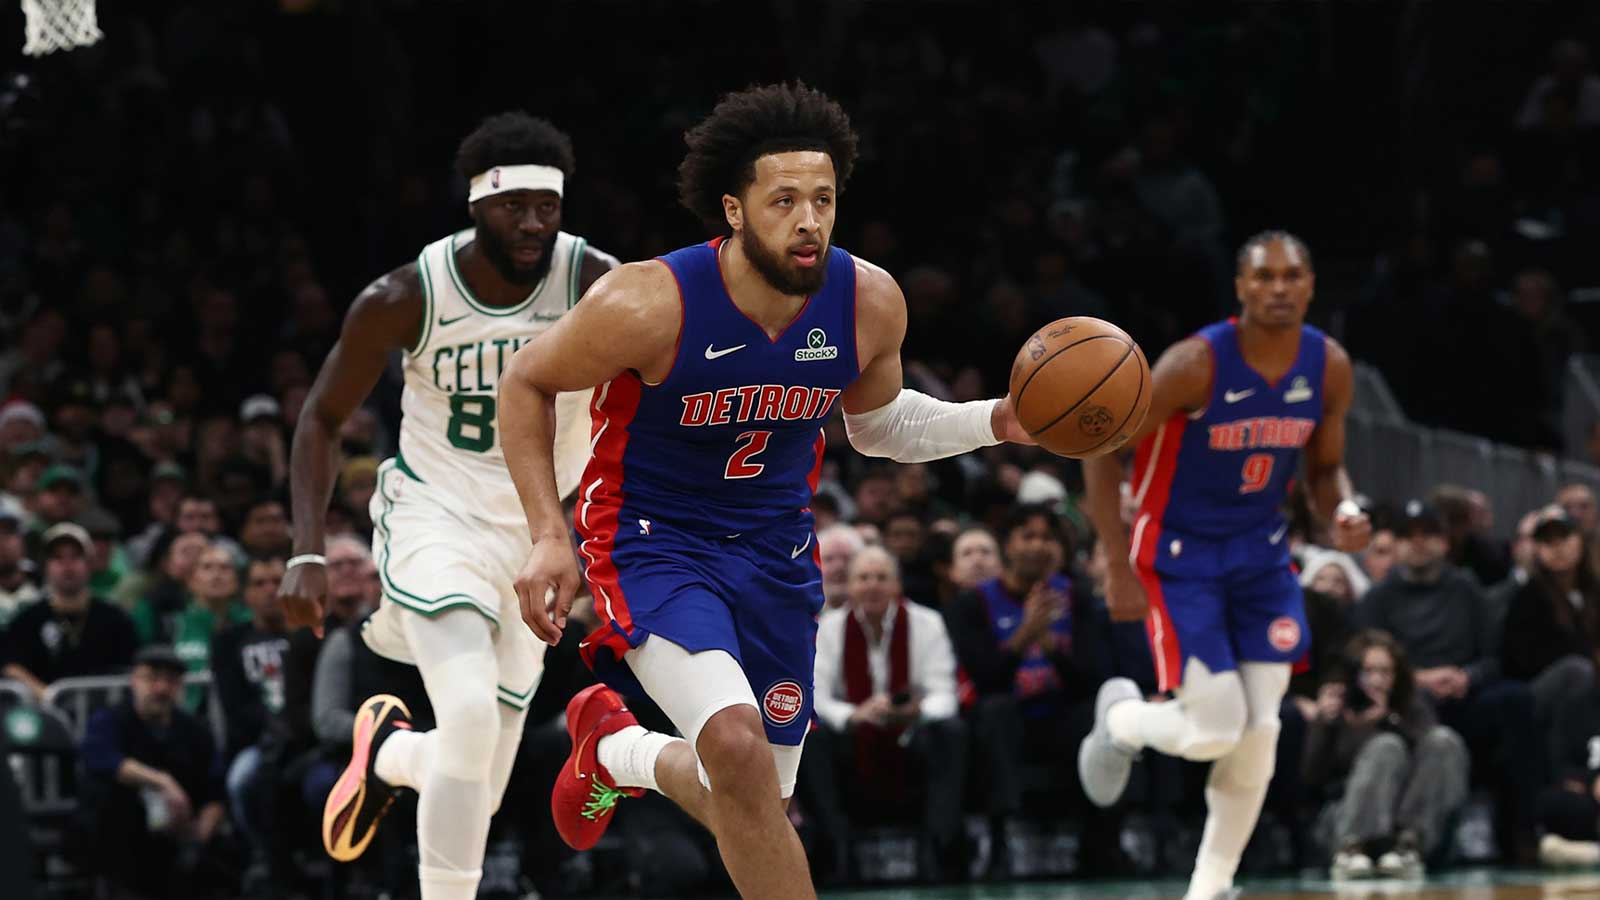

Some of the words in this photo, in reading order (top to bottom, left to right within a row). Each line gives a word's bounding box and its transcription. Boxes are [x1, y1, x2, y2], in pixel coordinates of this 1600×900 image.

[433, 339, 531, 392] CELT
[796, 348, 836, 360] StockX
[447, 393, 496, 453] 8
[679, 384, 842, 427] DETROIT
[724, 430, 774, 480] 2
[1208, 416, 1316, 451] DETROIT
[1239, 453, 1275, 495] 9
